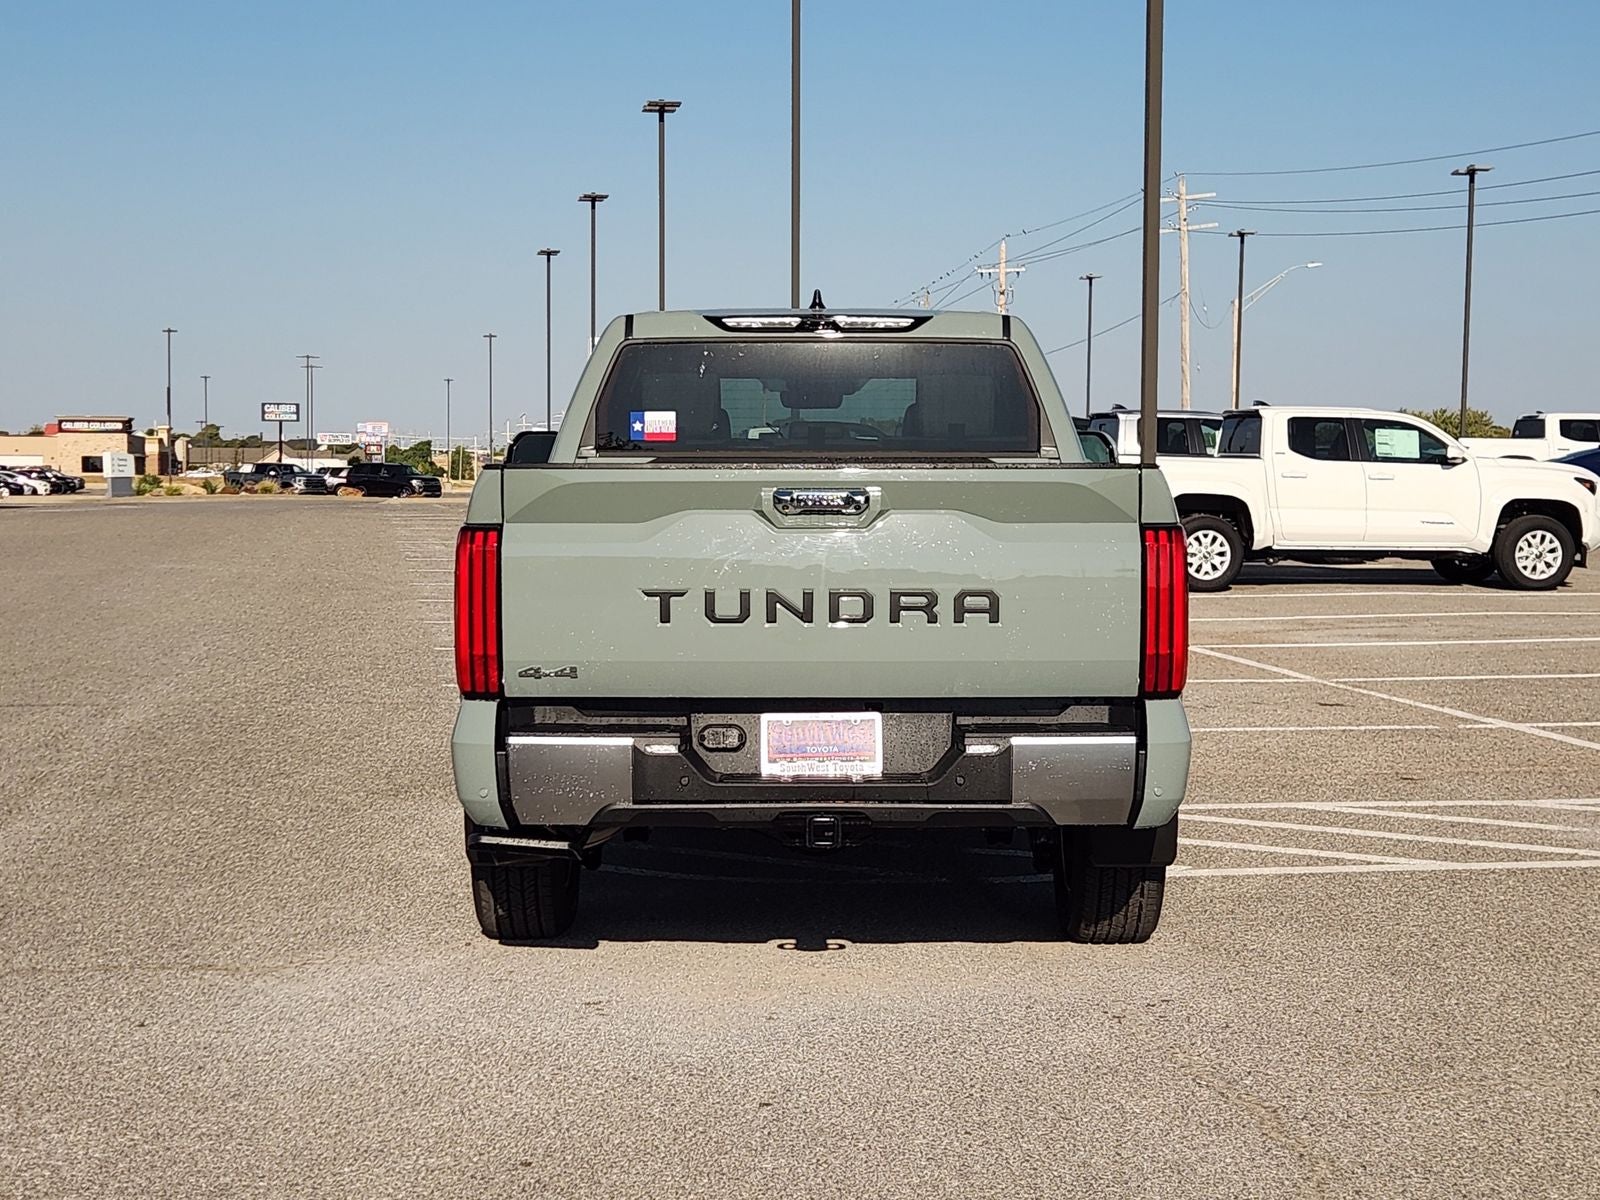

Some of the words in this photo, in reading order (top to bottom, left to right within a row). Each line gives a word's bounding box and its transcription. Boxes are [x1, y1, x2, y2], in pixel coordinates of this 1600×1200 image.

[264, 404, 297, 412] CALIBER
[641, 588, 1001, 625] TUNDRA
[780, 763, 829, 773] SouthWest
[832, 763, 865, 773] Toyota
